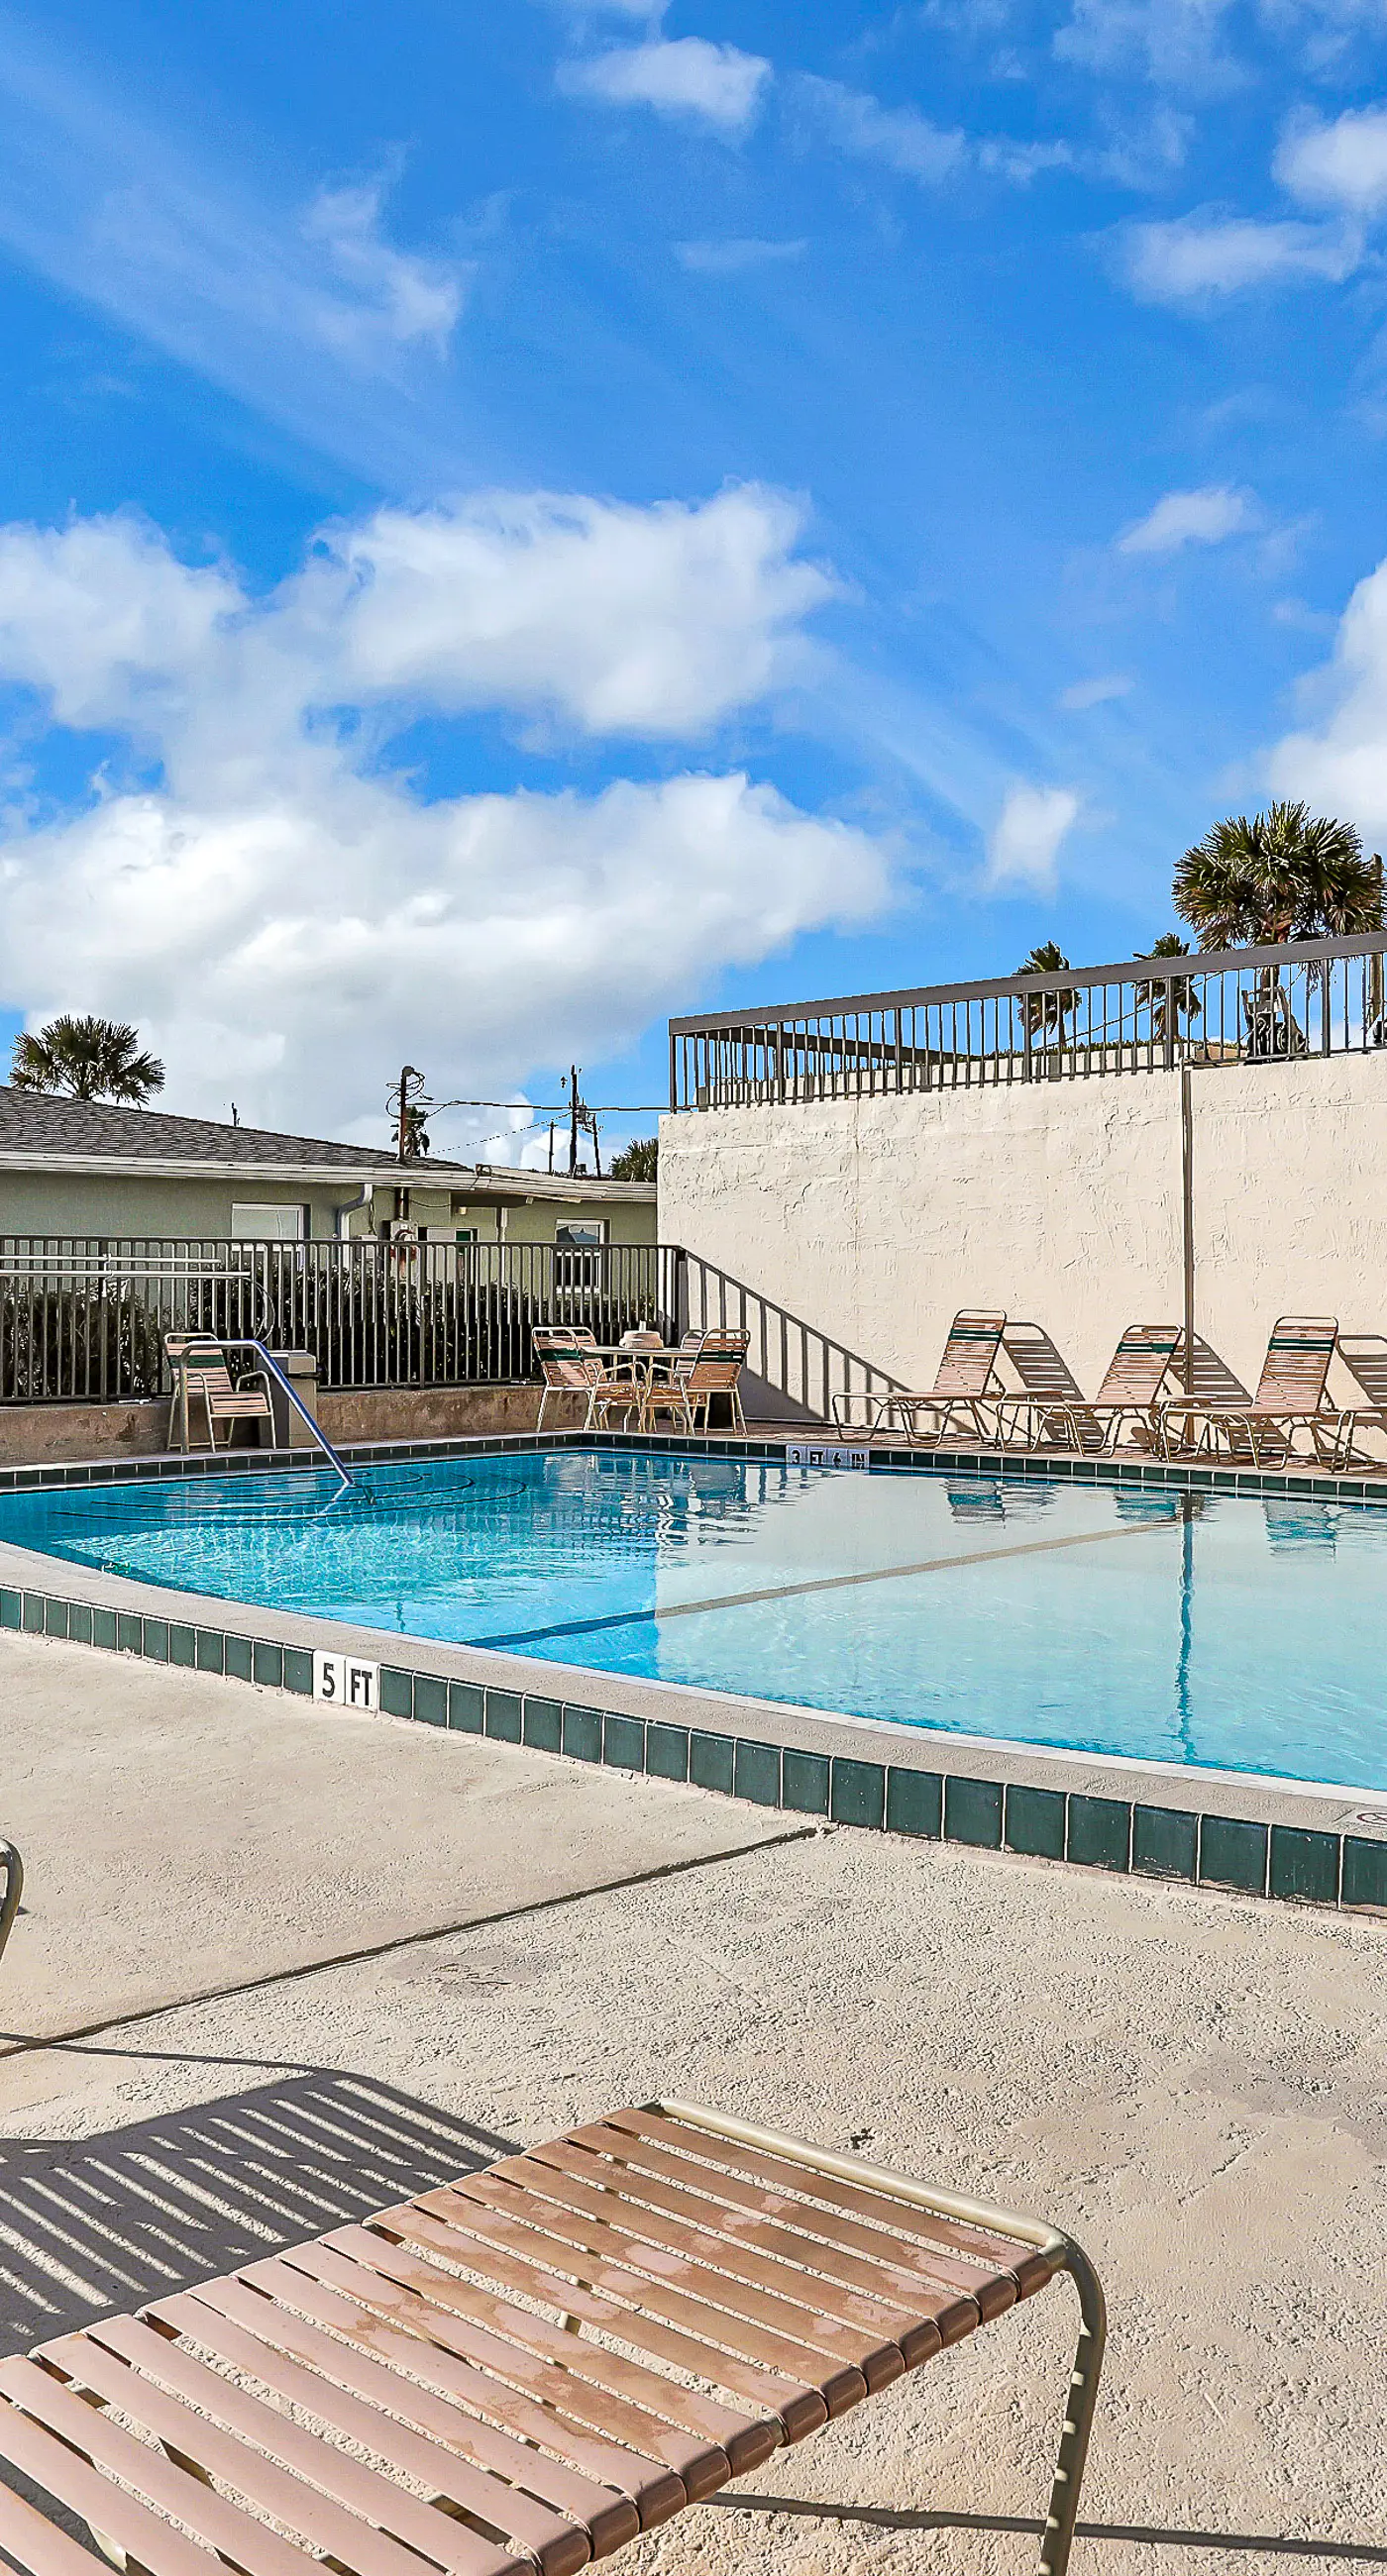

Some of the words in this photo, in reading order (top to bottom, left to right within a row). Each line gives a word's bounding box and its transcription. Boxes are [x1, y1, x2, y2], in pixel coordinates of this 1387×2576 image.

[792, 1449, 800, 1464] 3
[809, 1451, 823, 1466] FT
[322, 1663, 335, 1698] 5
[351, 1669, 373, 1705] FT
